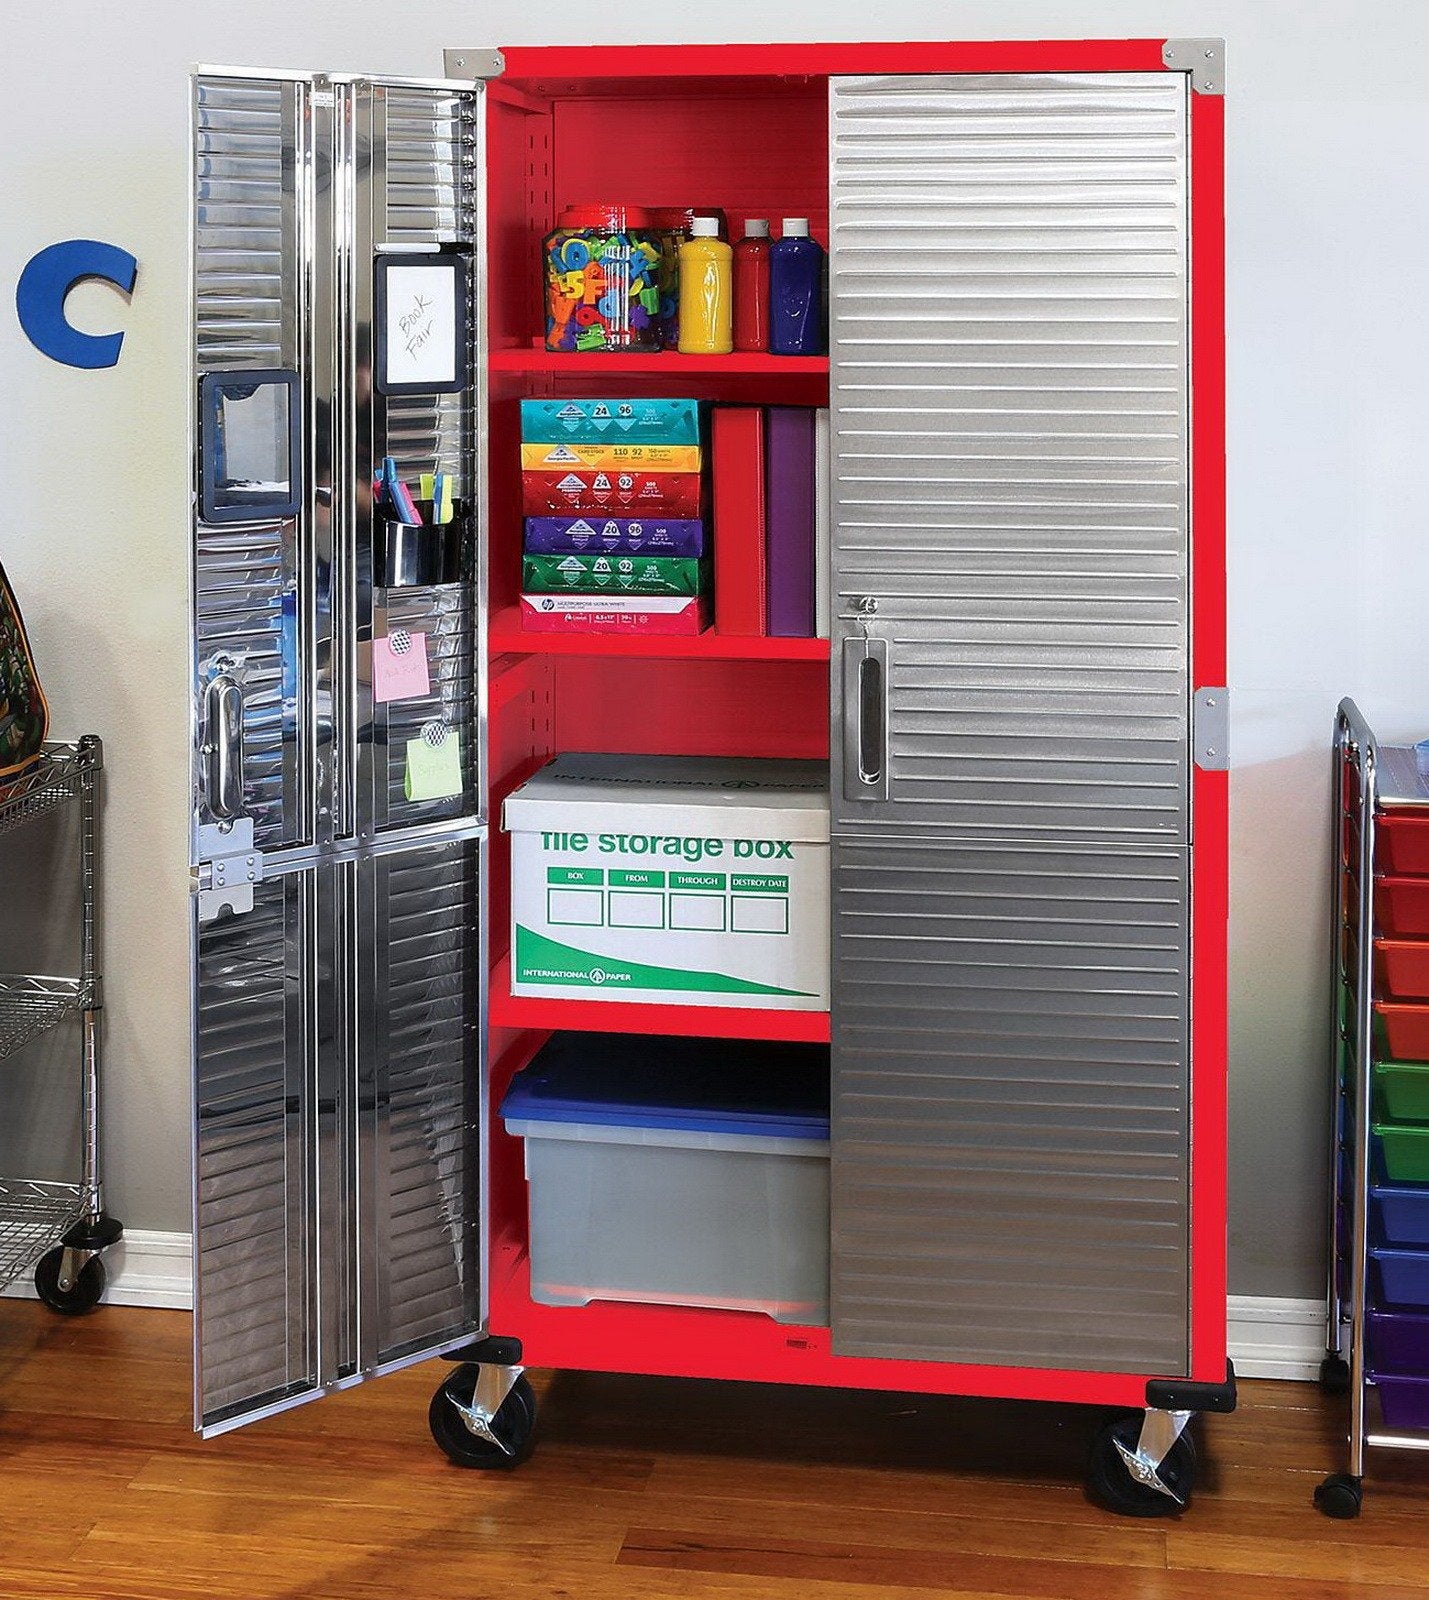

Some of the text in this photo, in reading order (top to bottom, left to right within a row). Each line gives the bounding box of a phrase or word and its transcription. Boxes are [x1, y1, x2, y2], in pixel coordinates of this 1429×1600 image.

[16, 239, 137, 369] C
[399, 295, 434, 338] Book
[405, 319, 434, 361] Fair
[596, 407, 607, 415] 24
[619, 406, 631, 414] 96
[613, 448, 628, 456] 110
[632, 448, 643, 456] 92
[596, 479, 607, 487] 24
[619, 478, 631, 486] 92
[606, 525, 617, 533] 20
[629, 525, 641, 534] 96
[596, 562, 607, 570] 20
[620, 562, 631, 570] 92
[541, 598, 555, 611] hp
[598, 832, 723, 862] storage
[567, 872, 584, 880] BOX
[625, 874, 649, 883] FROM
[677, 876, 718, 885] THROUGH
[732, 878, 787, 888] DESTROY DATE
[523, 969, 631, 981] INTERNATIONAL PAPER
